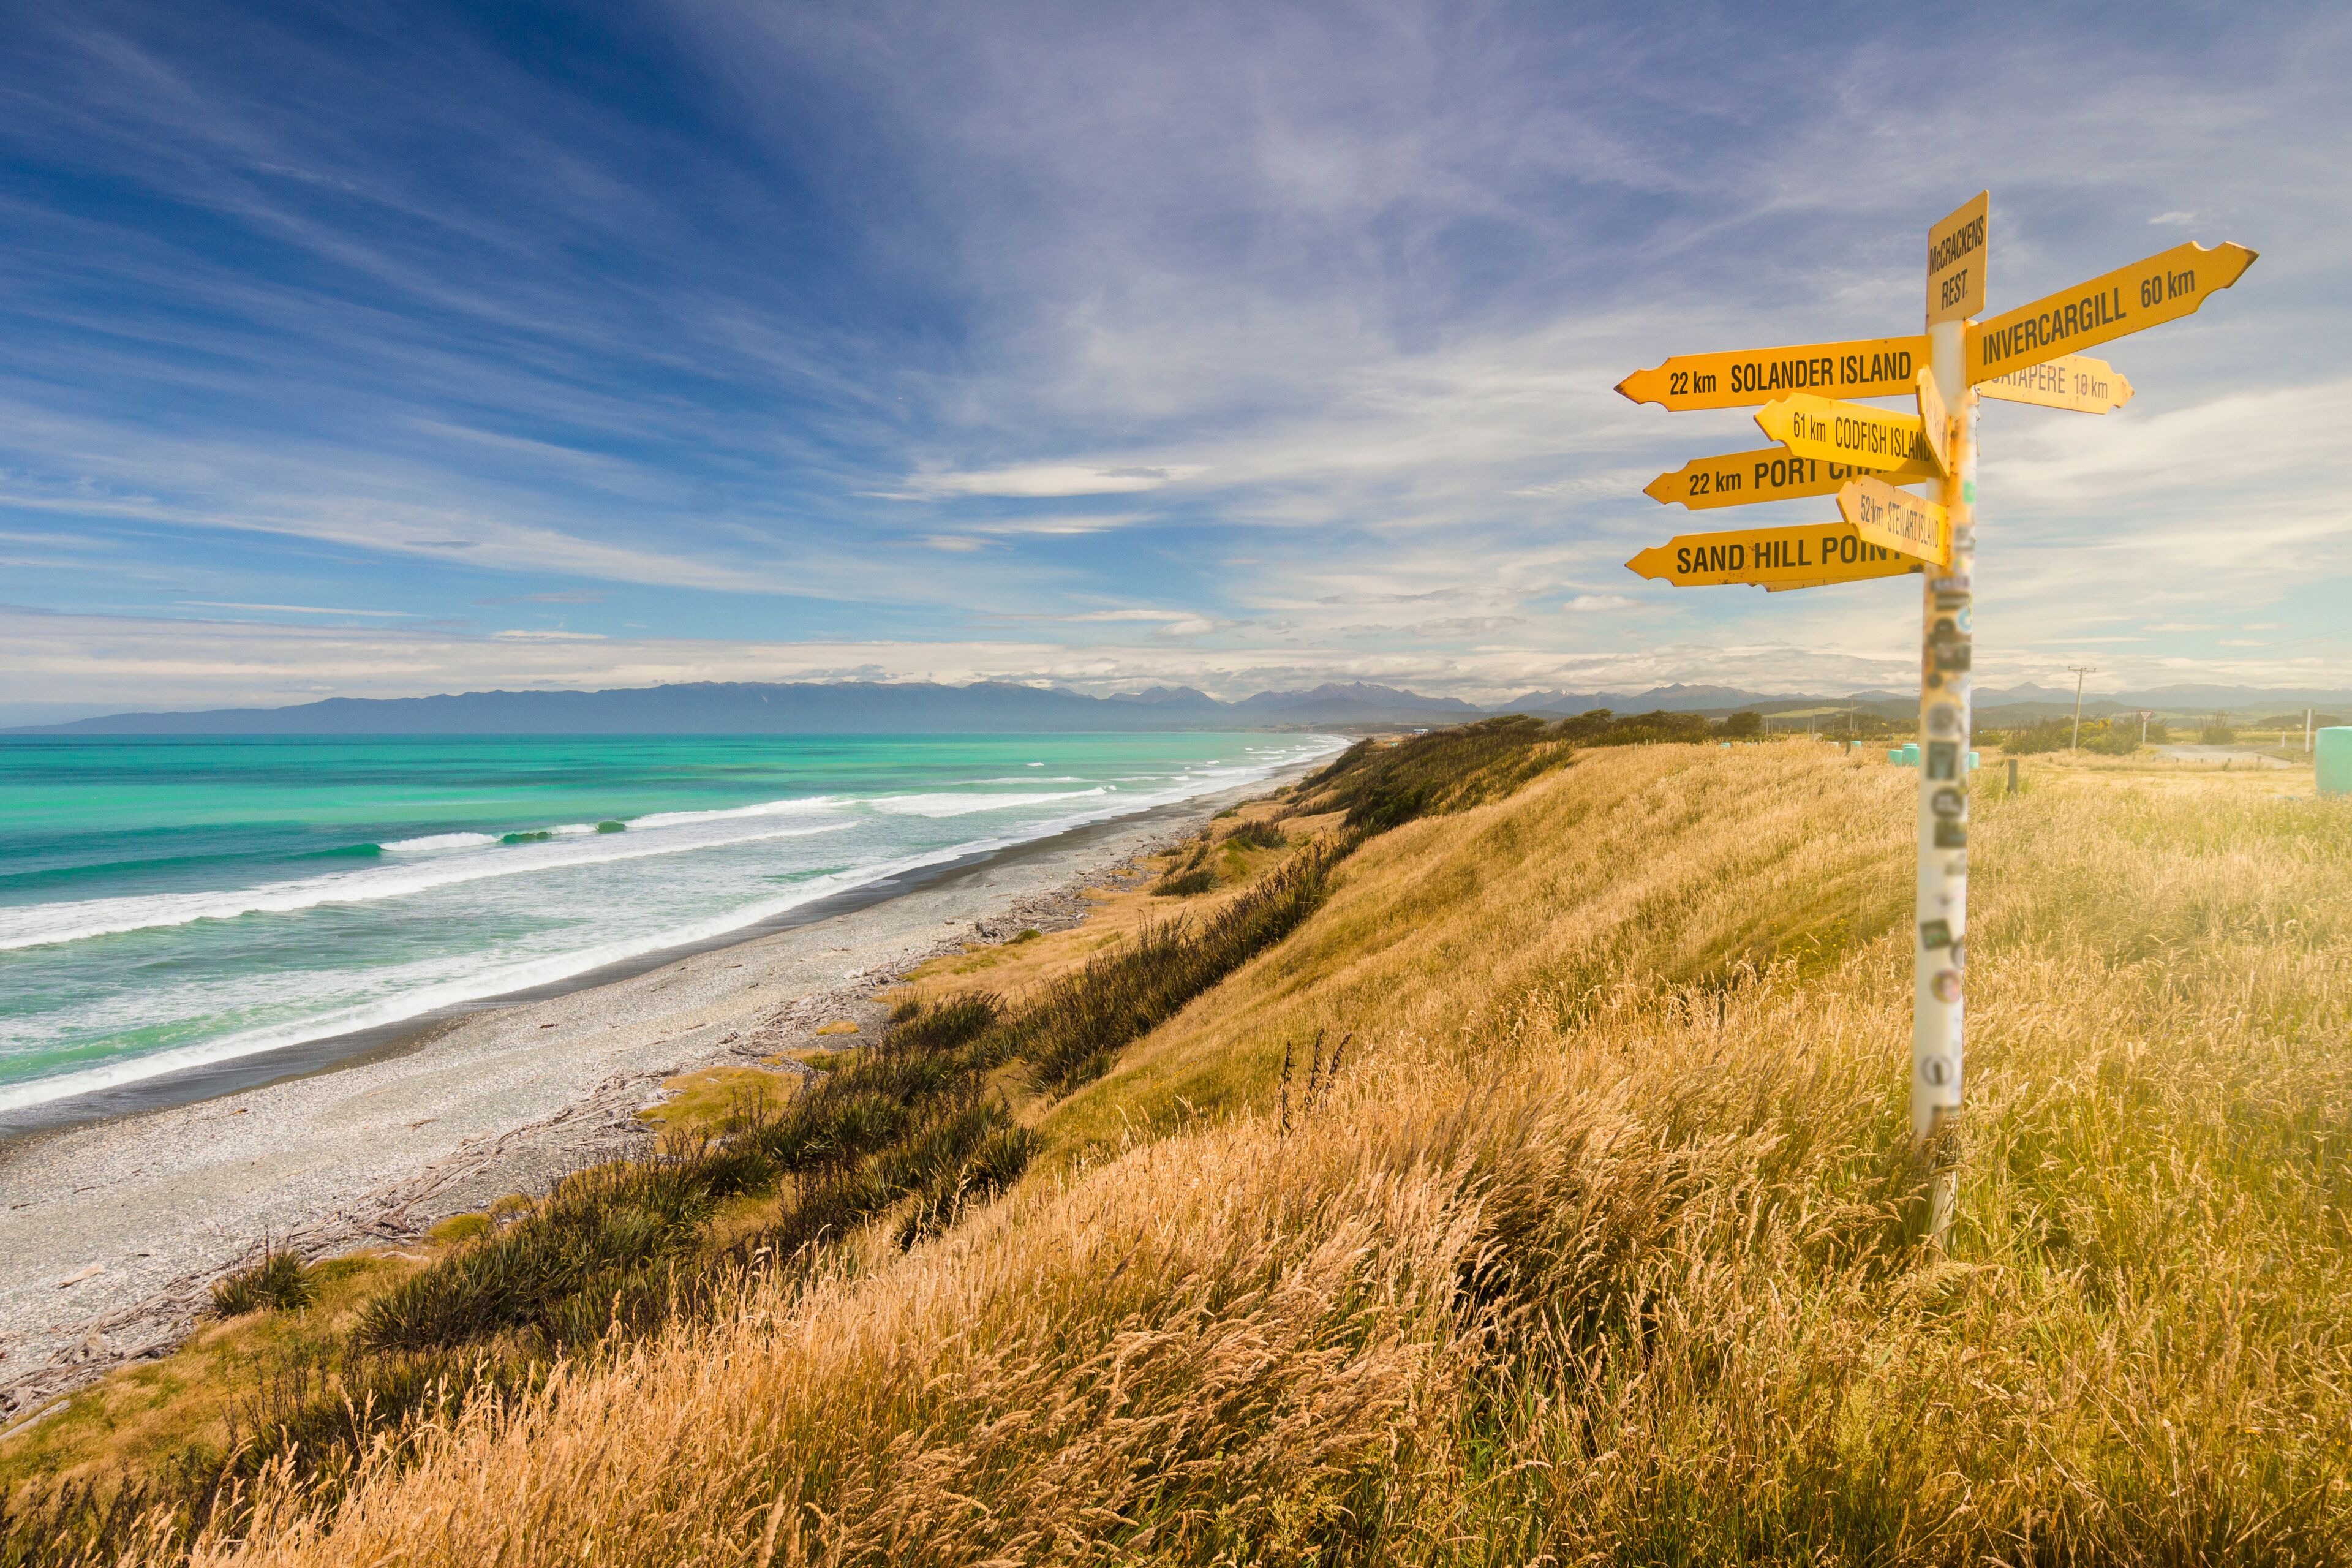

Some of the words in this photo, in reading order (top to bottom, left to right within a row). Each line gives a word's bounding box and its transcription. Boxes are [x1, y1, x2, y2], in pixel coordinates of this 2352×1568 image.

[1929, 215, 1984, 276] McCRACKENS
[1983, 287, 2127, 366] INVERCARGILL
[2141, 275, 2162, 309] 60
[2167, 270, 2195, 300] km
[1670, 372, 1688, 395] 22
[1693, 371, 1716, 394] km
[1731, 358, 1833, 393] SOLANDER
[1840, 351, 1912, 385] ISLAND
[2092, 375, 2108, 399] km
[1793, 412, 1806, 439] 61
[1810, 415, 1826, 442] km
[1835, 417, 1887, 454] CODFISH
[1689, 473, 1710, 496] 22
[1716, 471, 1741, 492] km
[1754, 458, 1815, 489] PORT
[1861, 494, 1870, 523] 52
[1872, 498, 1883, 527] km
[1888, 500, 1917, 541] STEWART
[1918, 513, 1939, 548] ISLAND
[1676, 544, 1744, 575] SAND
[1755, 539, 1812, 569] HILL
[1822, 535, 1900, 565] POIN
